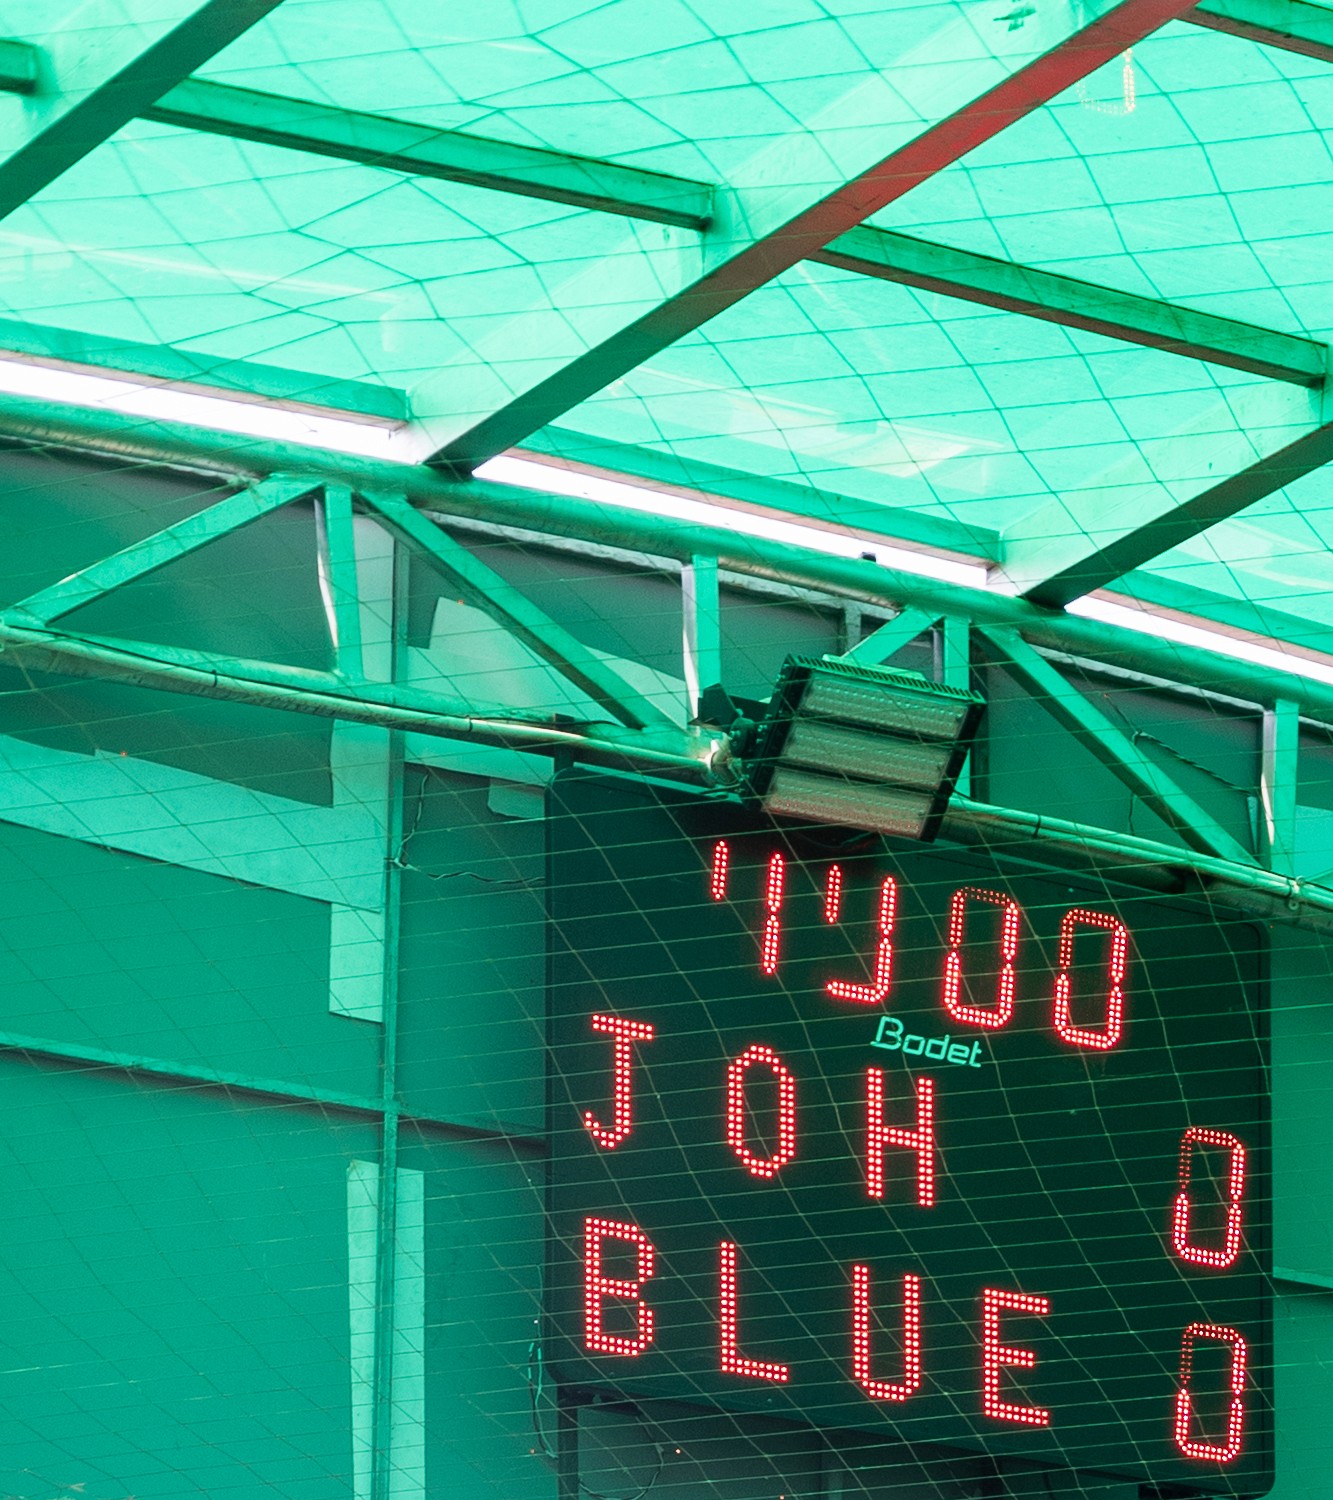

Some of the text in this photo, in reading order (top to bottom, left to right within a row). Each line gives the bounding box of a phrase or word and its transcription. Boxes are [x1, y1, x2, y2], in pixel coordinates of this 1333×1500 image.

[583, 1012, 1248, 1268] JOH 0
[869, 1015, 983, 1068] Bodet
[583, 1215, 1248, 1463] BLUE 0
